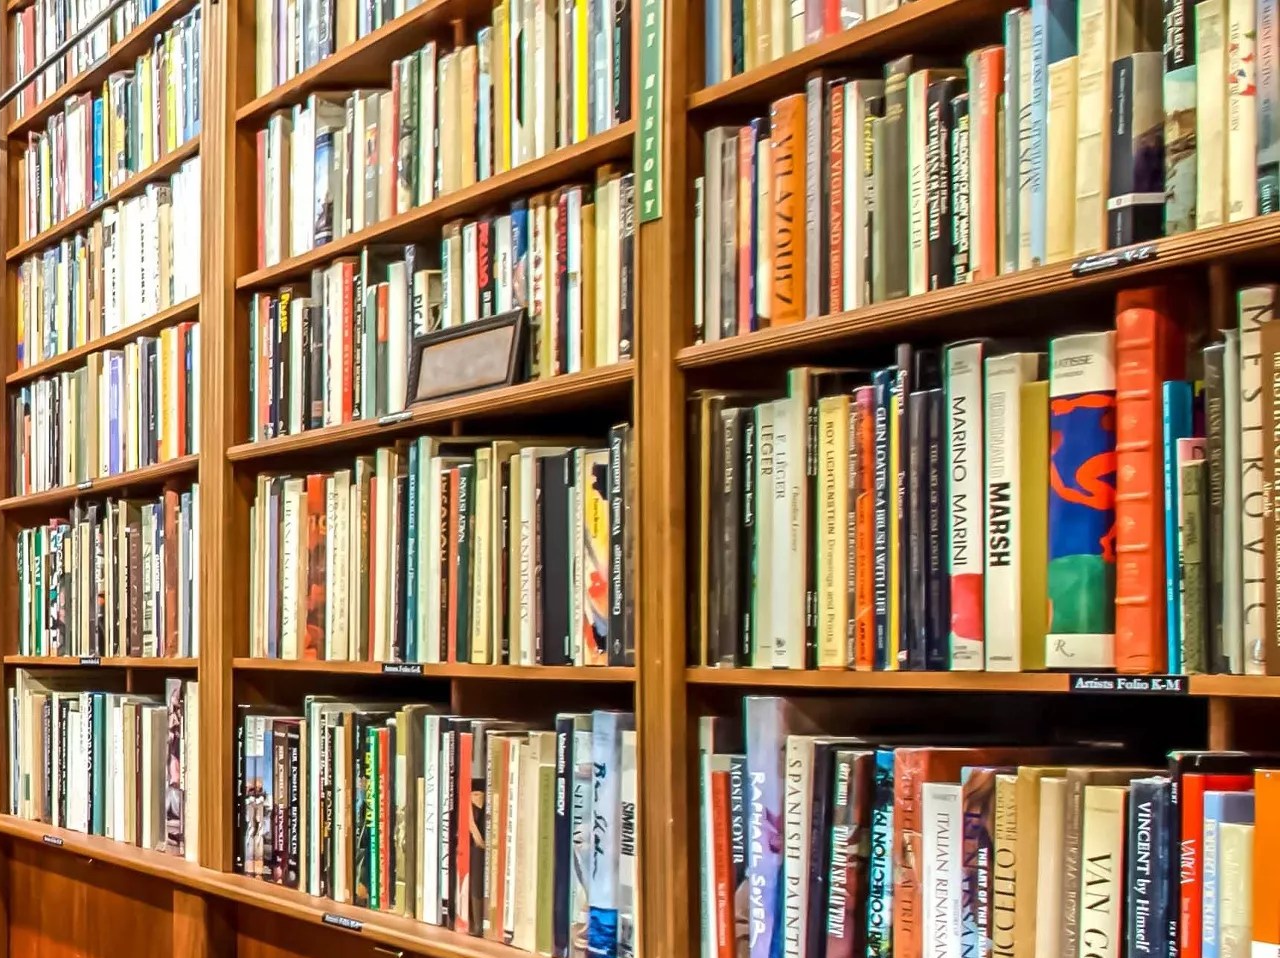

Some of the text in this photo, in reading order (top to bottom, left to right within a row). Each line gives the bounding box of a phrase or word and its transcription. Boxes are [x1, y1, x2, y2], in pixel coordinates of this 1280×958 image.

[643, 72, 656, 215] HISTORY
[831, 92, 841, 245] GUSTAV VIGELAND
[929, 101, 939, 241] VICTORIAN OUTSIDER
[1032, 142, 1042, 193] WILLIAMS
[912, 164, 922, 250] WHISTLER
[875, 407, 887, 443] GLEN
[1209, 397, 1221, 432] FRANK
[612, 437, 621, 493] Kandinsky
[775, 434, 789, 500] F. LÉGER
[847, 411, 857, 489] Norman Lindsay
[875, 444, 887, 490] LOATES
[930, 467, 939, 485] ART
[951, 396, 968, 566] MARINO MARINI
[1262, 481, 1272, 518] Abradale
[457, 513, 465, 543] NAGY
[825, 421, 836, 643] ROY LICHTENSTEIN Drawings and Prints
[875, 509, 886, 551] BRUSH
[930, 511, 939, 532] TOM
[988, 482, 1011, 567] MARSH
[520, 520, 530, 623] KANDINSKY
[875, 552, 886, 588] WITH
[930, 535, 939, 574] LOVELL
[875, 590, 886, 615] LIFE
[1075, 677, 1182, 691] Artists Folio K-M
[557, 733, 567, 816] Valentin SEROV
[730, 763, 745, 864] MOSES SOYER
[749, 771, 766, 867] RAPHAEL
[787, 759, 803, 861] SPANISH
[1135, 801, 1152, 875] VINCENT
[935, 812, 950, 873] ITALIAN
[978, 848, 988, 867] THE
[1179, 839, 1197, 884] VARGA
[827, 825, 848, 938] TOULOUSE-LAUTREC
[869, 832, 888, 926] COLLECTION
[978, 869, 988, 888] ART
[978, 889, 987, 904] OF
[1084, 851, 1112, 915] VAN
[1134, 878, 1152, 895] by
[1202, 817, 1217, 944] ROBERT VICKREY
[978, 905, 987, 925] THE
[1134, 898, 1152, 952] Himself
